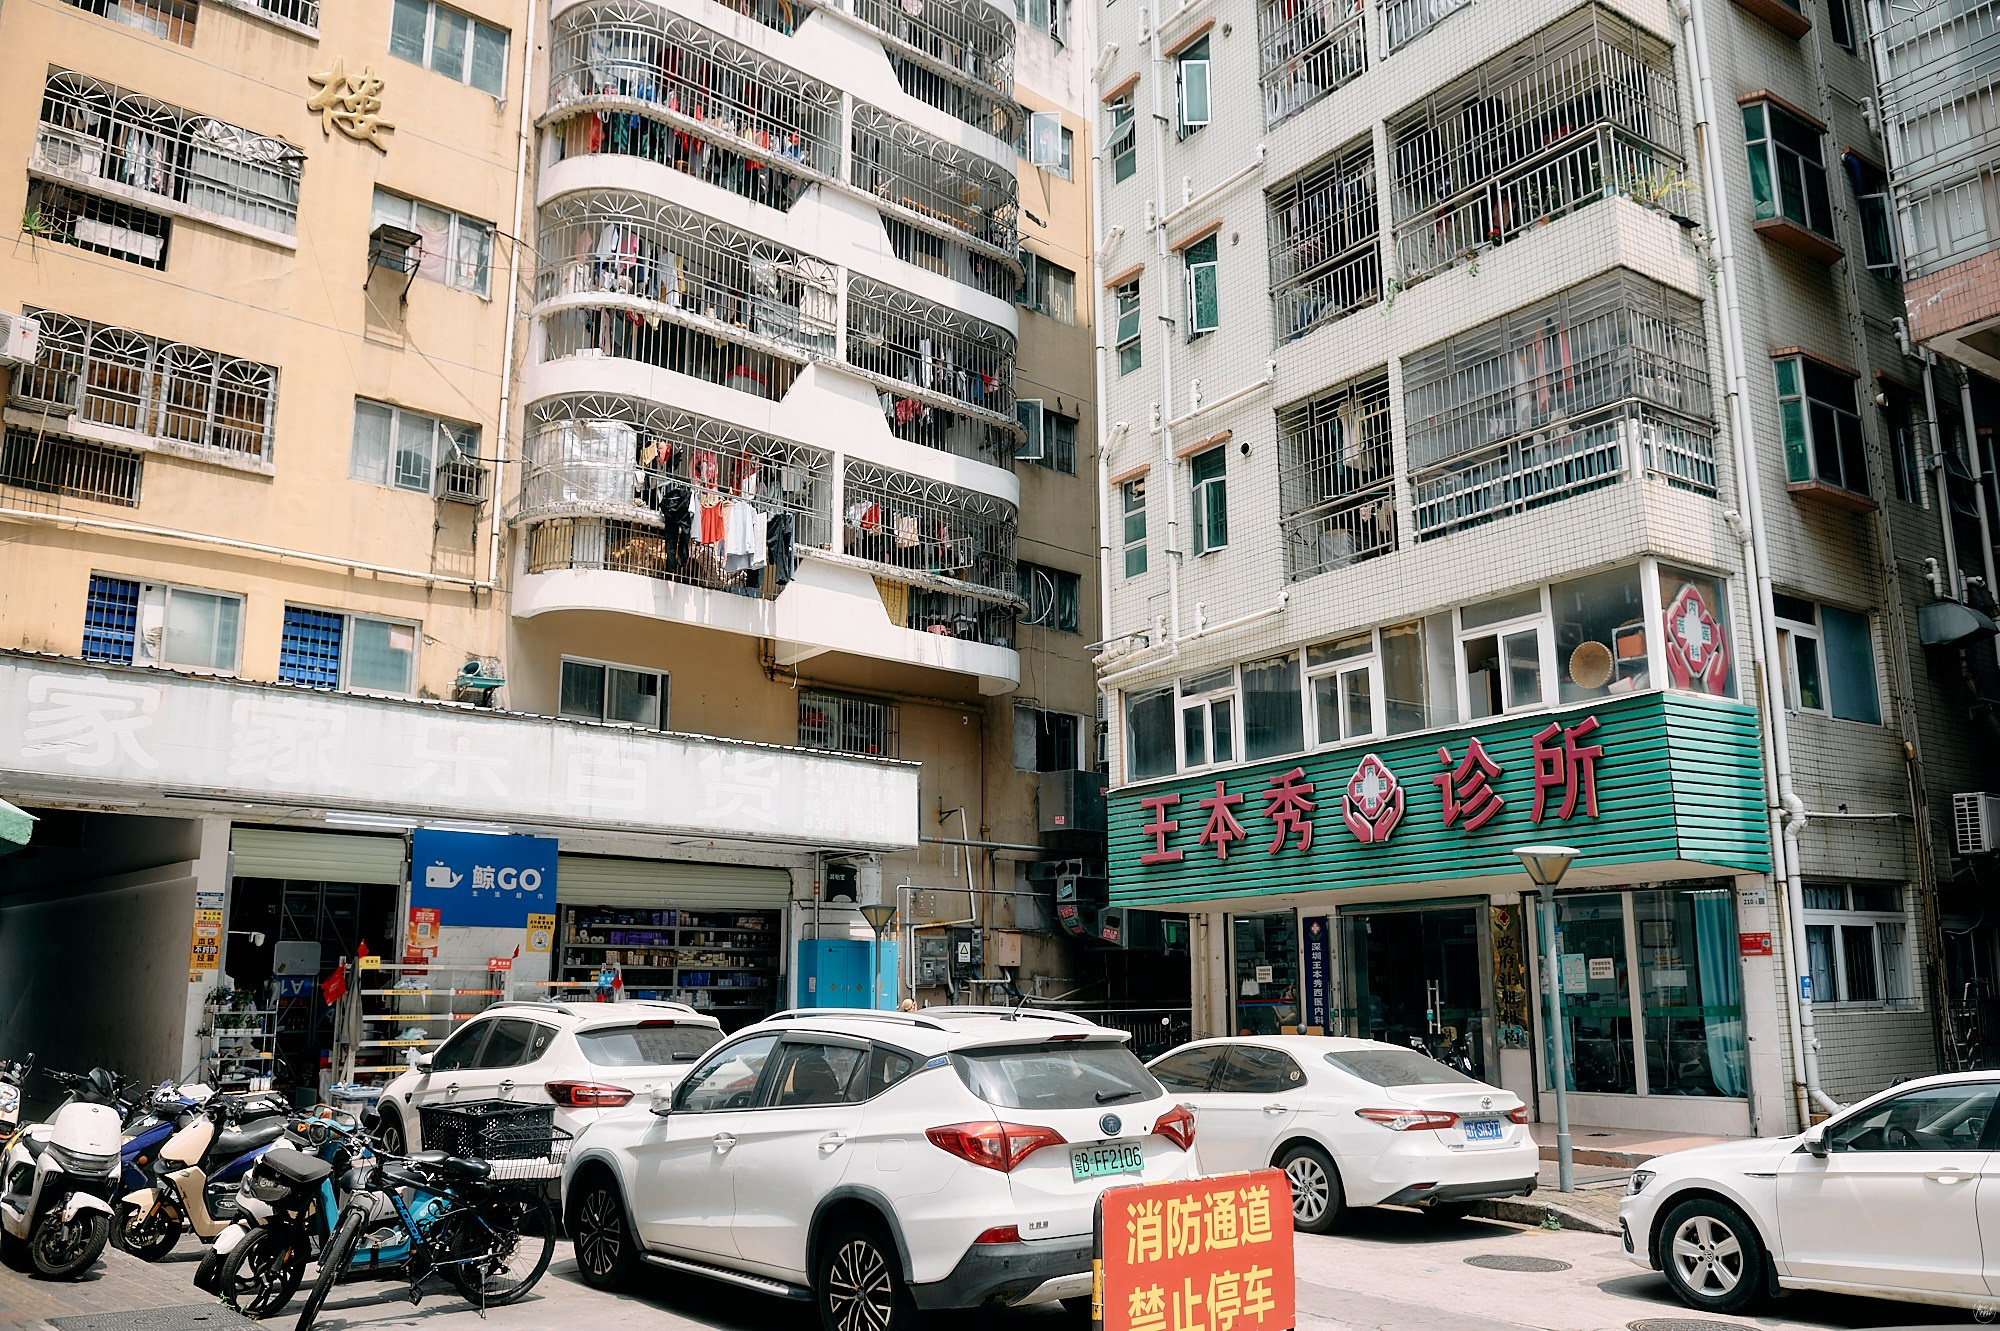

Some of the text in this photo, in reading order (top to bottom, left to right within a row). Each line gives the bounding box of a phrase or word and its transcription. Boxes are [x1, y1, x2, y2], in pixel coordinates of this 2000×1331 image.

[307, 55, 395, 153] 楼
[1311, 942, 1324, 1025] 深圳王本秀西医内科
[1126, 1184, 1273, 1265] 消防通道
[1128, 1264, 1275, 1331] 禁止停车
